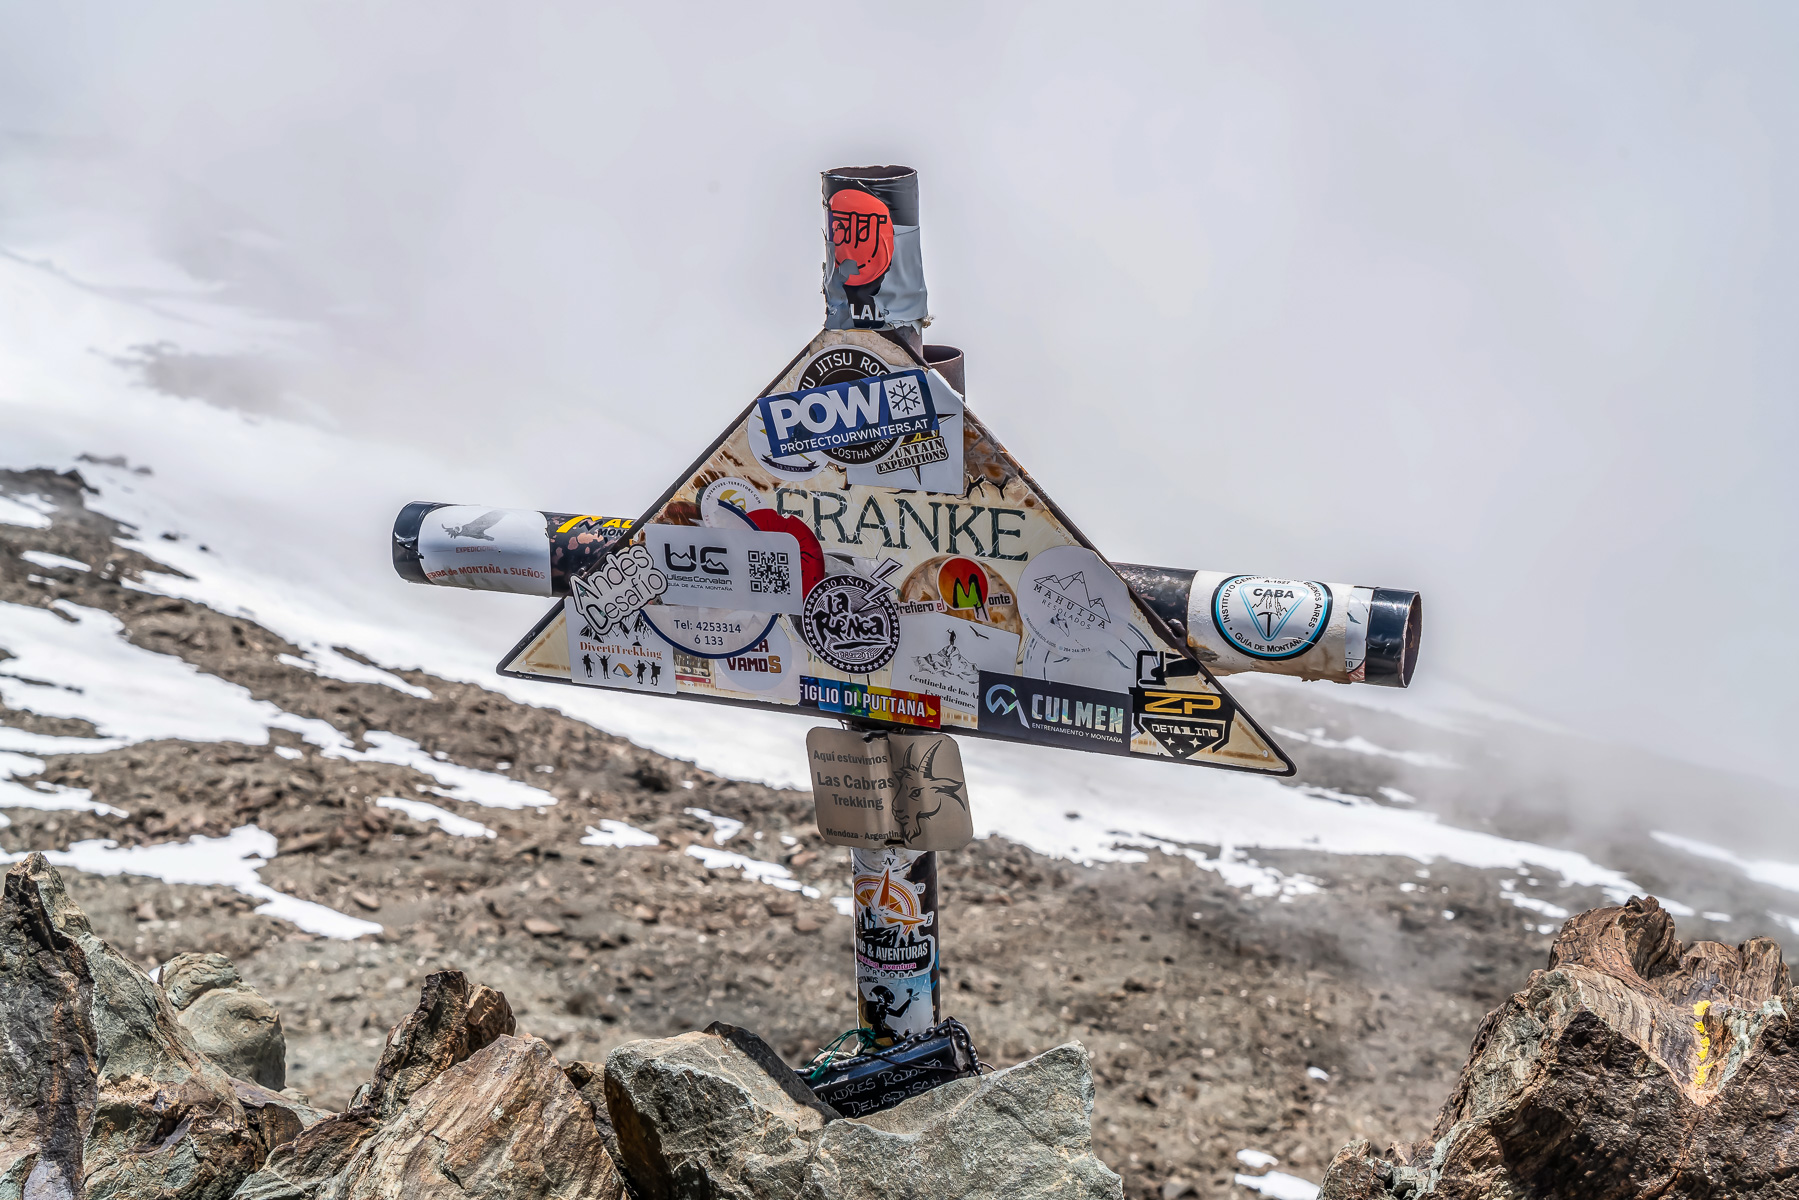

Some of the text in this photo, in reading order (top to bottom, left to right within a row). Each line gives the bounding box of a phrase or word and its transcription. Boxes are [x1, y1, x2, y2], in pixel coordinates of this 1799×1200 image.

[815, 352, 852, 376] JITSU
[769, 382, 881, 440] POW
[780, 418, 929, 454] PROTECTOURWINTERS.AT
[831, 447, 871, 460] COSTHA
[878, 448, 948, 473] EXPEDITIONS
[598, 528, 626, 537] MON
[775, 487, 1028, 562] FRANKE
[448, 567, 458, 576] de
[459, 563, 501, 575] MONTAÑA
[510, 567, 546, 580] SUEÑOS
[574, 549, 650, 611] Andes
[693, 575, 733, 585] Corvalan
[705, 584, 734, 592] MONTAÑA
[824, 576, 872, 591] 30 AÑOS
[1252, 588, 1295, 599] CABA
[585, 573, 664, 630] Desafío
[936, 598, 946, 611] el
[1033, 583, 1106, 630] MAHUIDA
[1221, 584, 1236, 624] INSTITUTO
[1303, 581, 1323, 629] BUENOS AIRES
[1041, 598, 1092, 630] RESOLADOS
[673, 619, 742, 634] Tel: 4253314
[704, 635, 724, 646] 133
[1234, 632, 1304, 653] GUÍA DE MONTAÑA
[580, 641, 663, 661] DivertiTrekking
[726, 655, 782, 674] VAMOS
[909, 674, 947, 691] Centinela
[947, 684, 958, 693] de
[958, 687, 970, 697] los
[844, 690, 858, 707] DI
[862, 692, 926, 719] PUTTANA
[1031, 693, 1124, 734] CULMEN
[1031, 722, 1084, 737] ENTRENAMIENTO
[1090, 732, 1123, 744] MONTAÑA
[1151, 723, 1219, 738] DETAILING
[813, 749, 889, 766] Aquí estuvimos
[816, 771, 895, 791] Las Cabras
[831, 793, 885, 811] Trekking
[825, 827, 859, 839] Mendoza
[867, 943, 875, 958] &
[875, 941, 928, 962] AVENTURAS
[860, 962, 914, 979] CORDOBA
[820, 1078, 876, 1104] ANDRES
